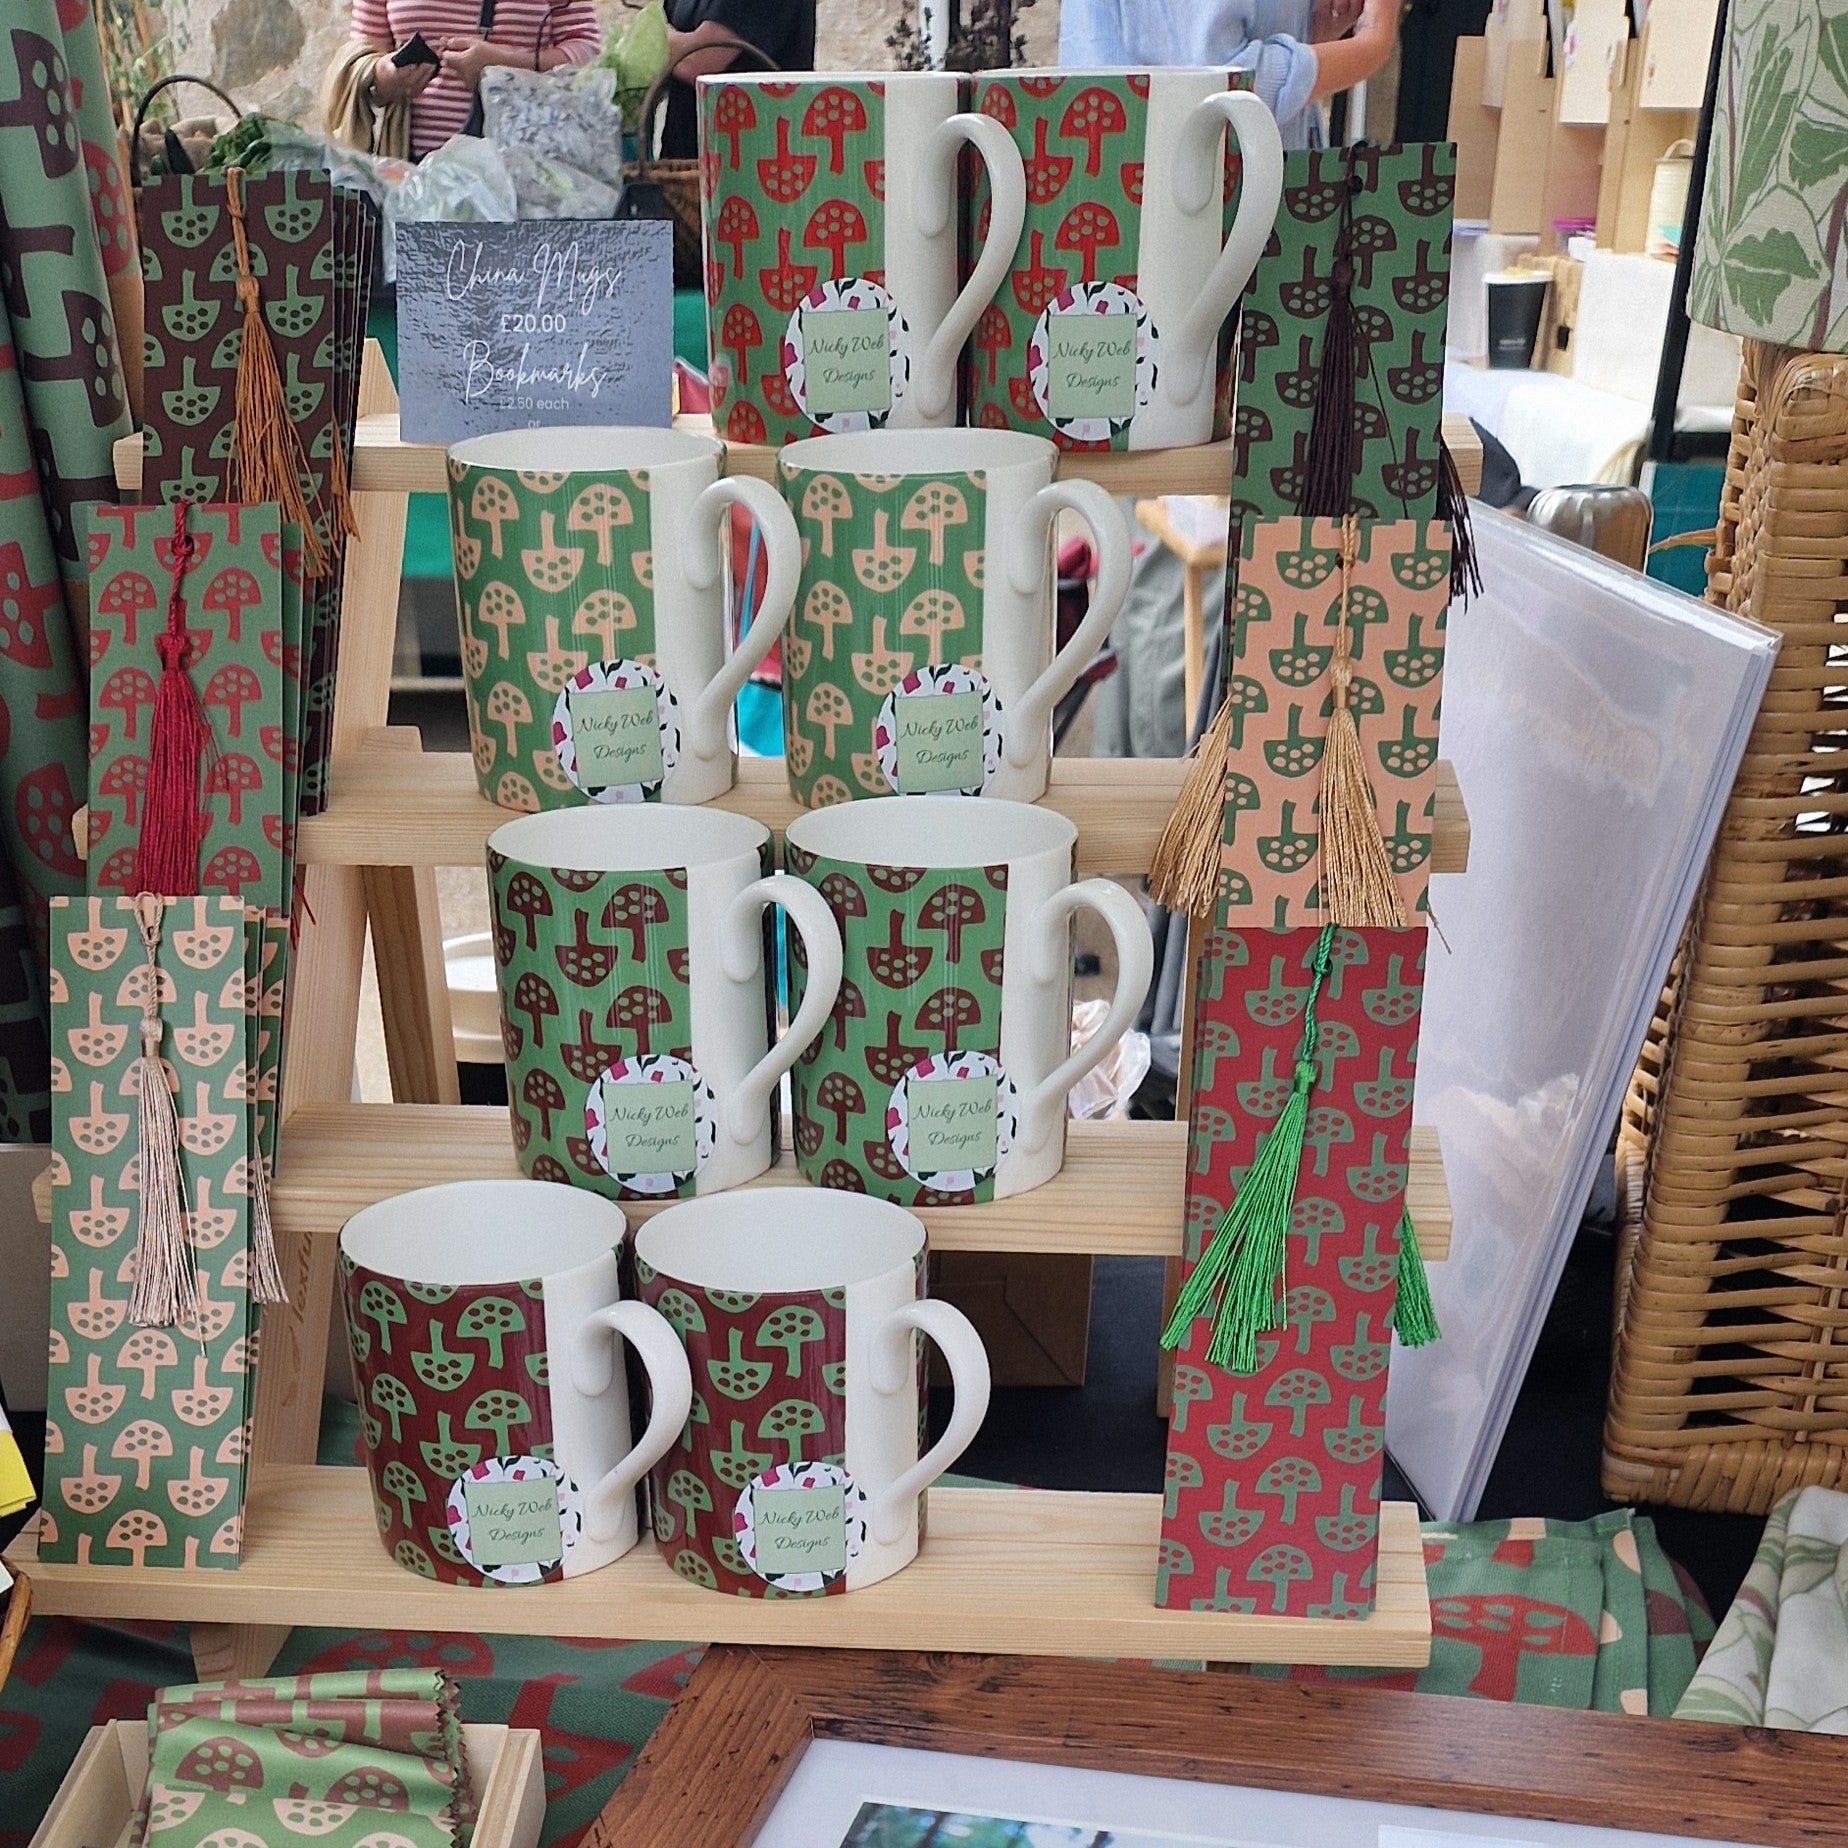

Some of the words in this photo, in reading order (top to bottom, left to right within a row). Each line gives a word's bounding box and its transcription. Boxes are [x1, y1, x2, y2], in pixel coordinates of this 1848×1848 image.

[446, 238, 525, 301] China
[532, 240, 623, 316] Mugs
[500, 313, 567, 333] £20.00
[807, 336, 849, 359] Nicky
[851, 333, 885, 353] Web
[1051, 340, 1094, 364] Nicky
[1097, 339, 1132, 358] Web
[462, 339, 608, 405] Bookmarks
[822, 367, 876, 390] Designs
[1065, 372, 1121, 395] Designs
[536, 397, 570, 410] each
[575, 715, 618, 737] Nicky
[620, 709, 654, 729] Web
[899, 719, 943, 741] Nicky
[945, 714, 979, 735] Web
[592, 743, 647, 764] Designs
[915, 749, 970, 769] Designs
[607, 1106, 652, 1127] Nicky
[654, 1102, 690, 1121] Web
[911, 1103, 956, 1124] Nicky
[959, 1097, 993, 1118] Web
[624, 1133, 681, 1153] Designs
[927, 1130, 983, 1150] Designs
[470, 1503, 515, 1522] Nicky
[517, 1497, 553, 1516] Web
[757, 1510, 802, 1530] Nicky
[805, 1505, 840, 1524] Web
[488, 1527, 545, 1546] Designs
[773, 1536, 831, 1554] Designs
